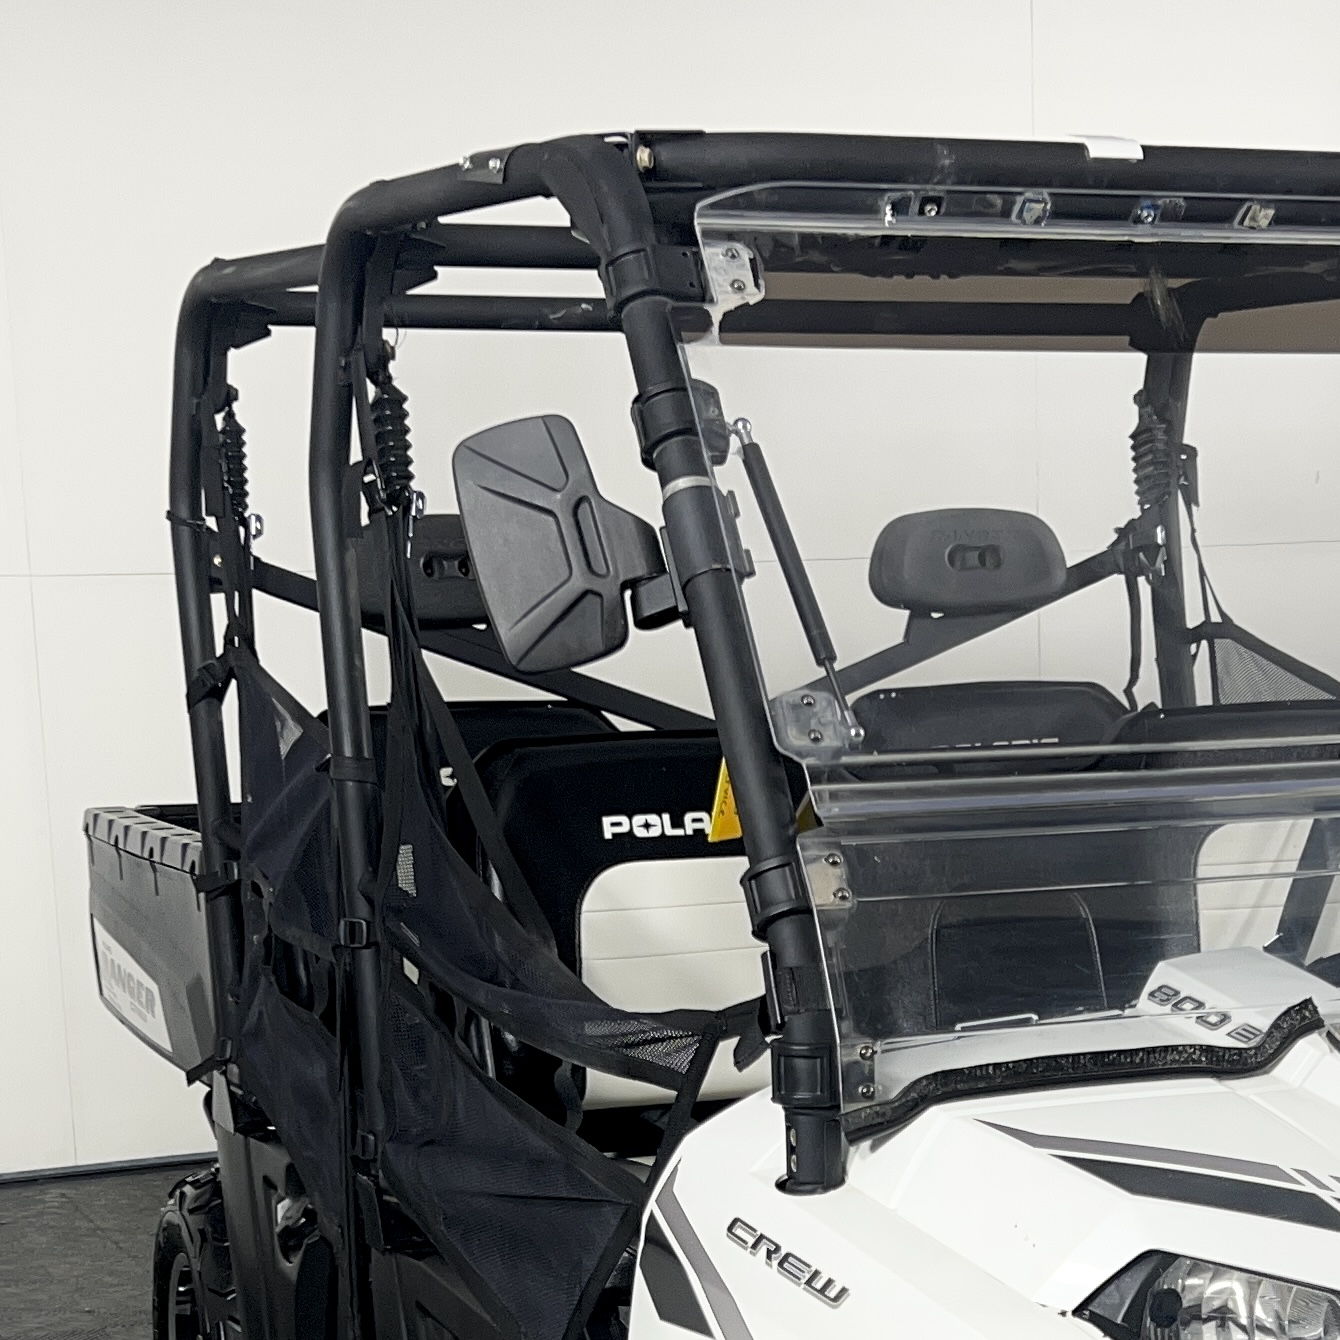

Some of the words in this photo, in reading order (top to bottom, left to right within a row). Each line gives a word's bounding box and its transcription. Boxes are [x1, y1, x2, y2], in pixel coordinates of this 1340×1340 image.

[602, 811, 712, 839] POLA
[1147, 985, 1232, 1031] 800
[726, 1217, 850, 1309] CREW
